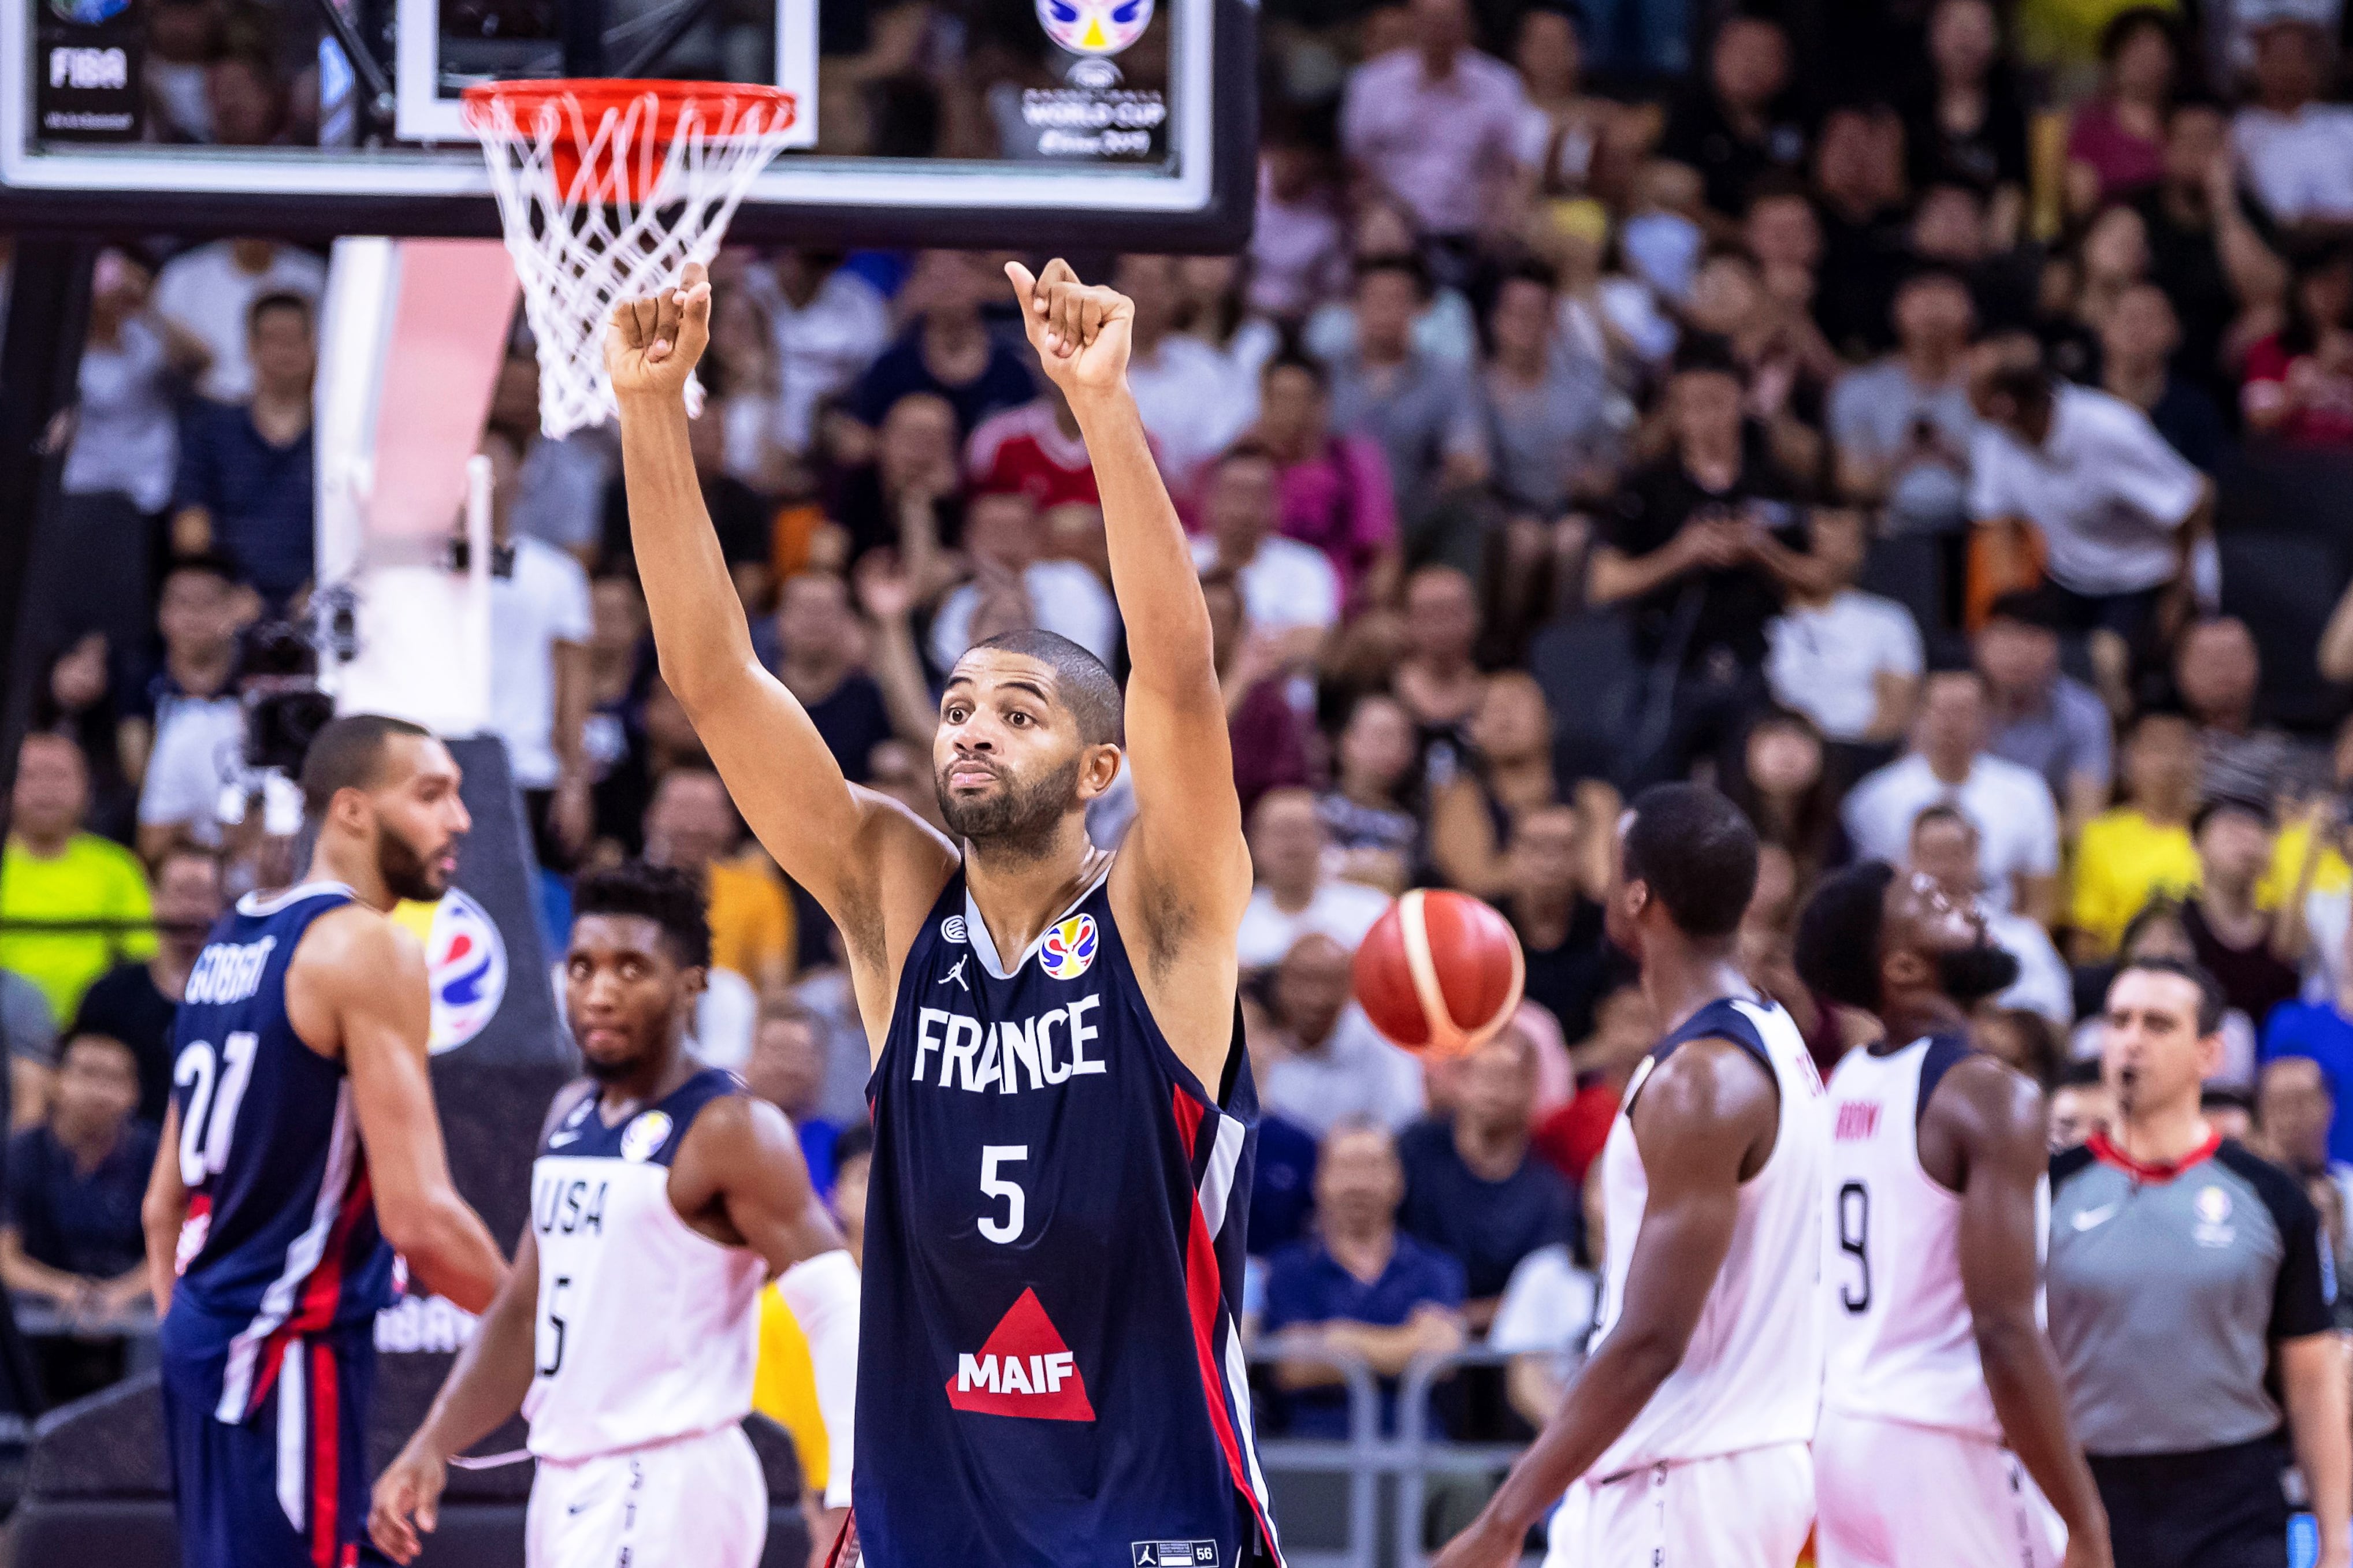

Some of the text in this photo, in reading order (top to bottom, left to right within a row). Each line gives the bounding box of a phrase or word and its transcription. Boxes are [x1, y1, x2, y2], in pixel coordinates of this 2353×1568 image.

[50, 47, 128, 89] FIBA
[912, 993, 1107, 1094] FRANCE
[174, 1030, 259, 1186] 21
[538, 1178, 608, 1236] USA
[977, 1145, 1028, 1244] 5
[1839, 1182, 1871, 1313] 9
[540, 1275, 573, 1379] 5
[957, 1350, 1073, 1394] MAIF
[1196, 1547, 1213, 1560] 56
